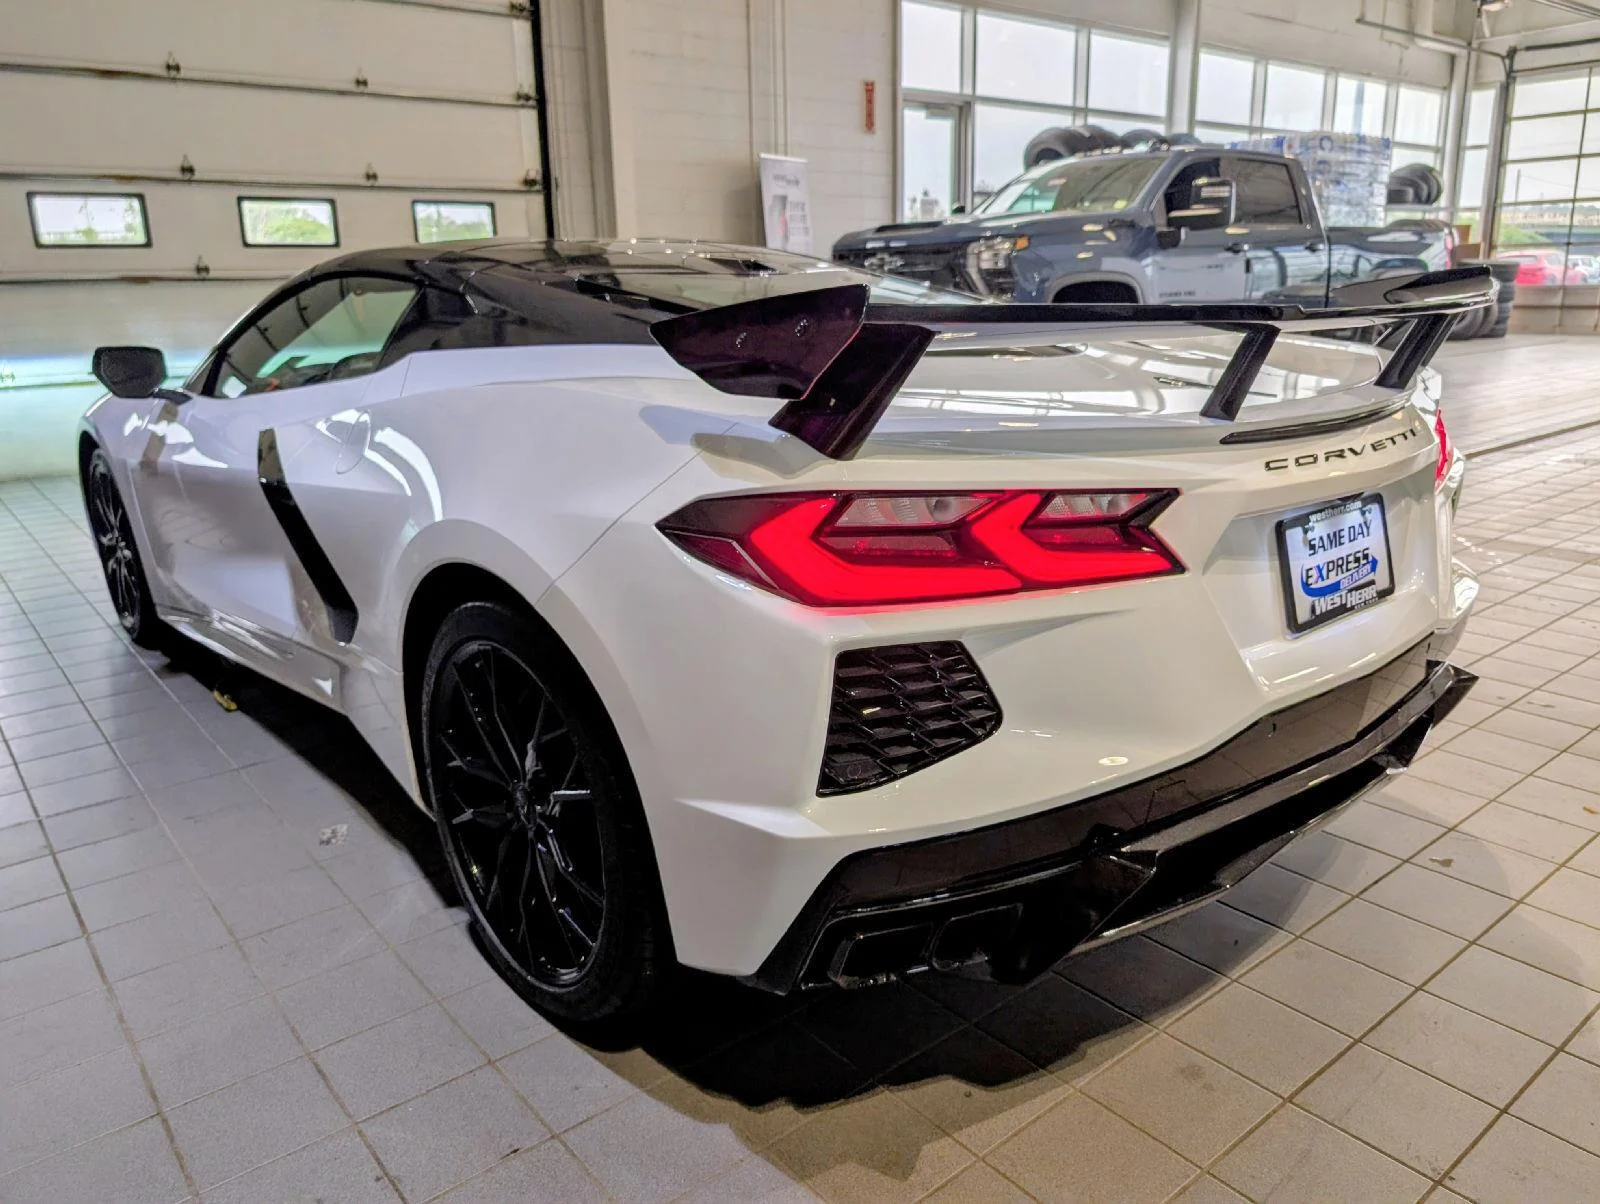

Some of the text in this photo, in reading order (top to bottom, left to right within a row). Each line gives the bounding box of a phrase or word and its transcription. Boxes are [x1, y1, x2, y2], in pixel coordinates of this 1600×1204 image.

[1308, 520, 1373, 557] SAME DAY
[1305, 547, 1370, 587] EXPRESS
[1340, 564, 1373, 588] DELIVERY
